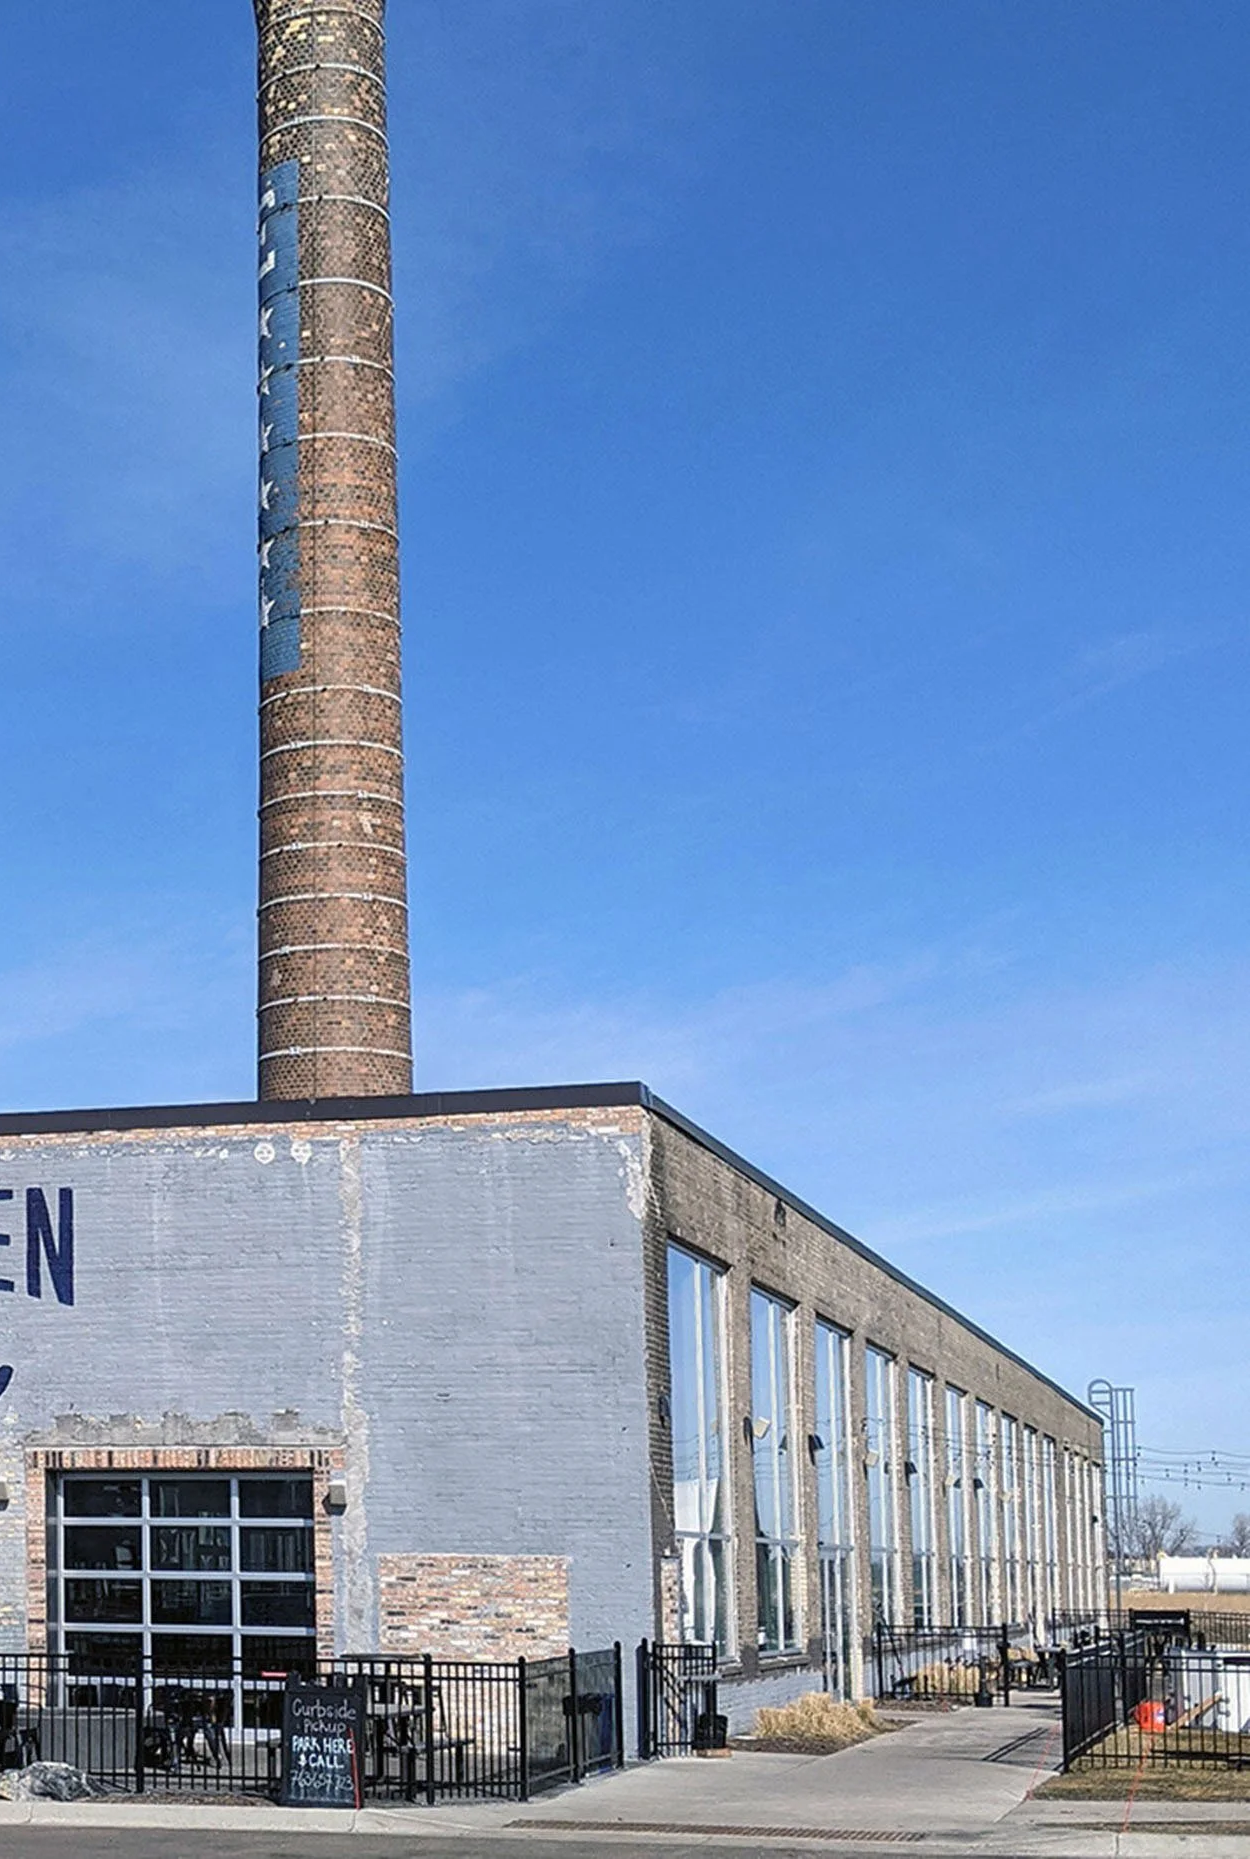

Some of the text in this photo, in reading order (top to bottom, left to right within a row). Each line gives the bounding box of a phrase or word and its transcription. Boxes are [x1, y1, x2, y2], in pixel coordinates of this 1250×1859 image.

[292, 1698, 356, 1720] Curbside
[292, 1735, 355, 1754] PARK HERE
[308, 1753, 344, 1769] CALL
